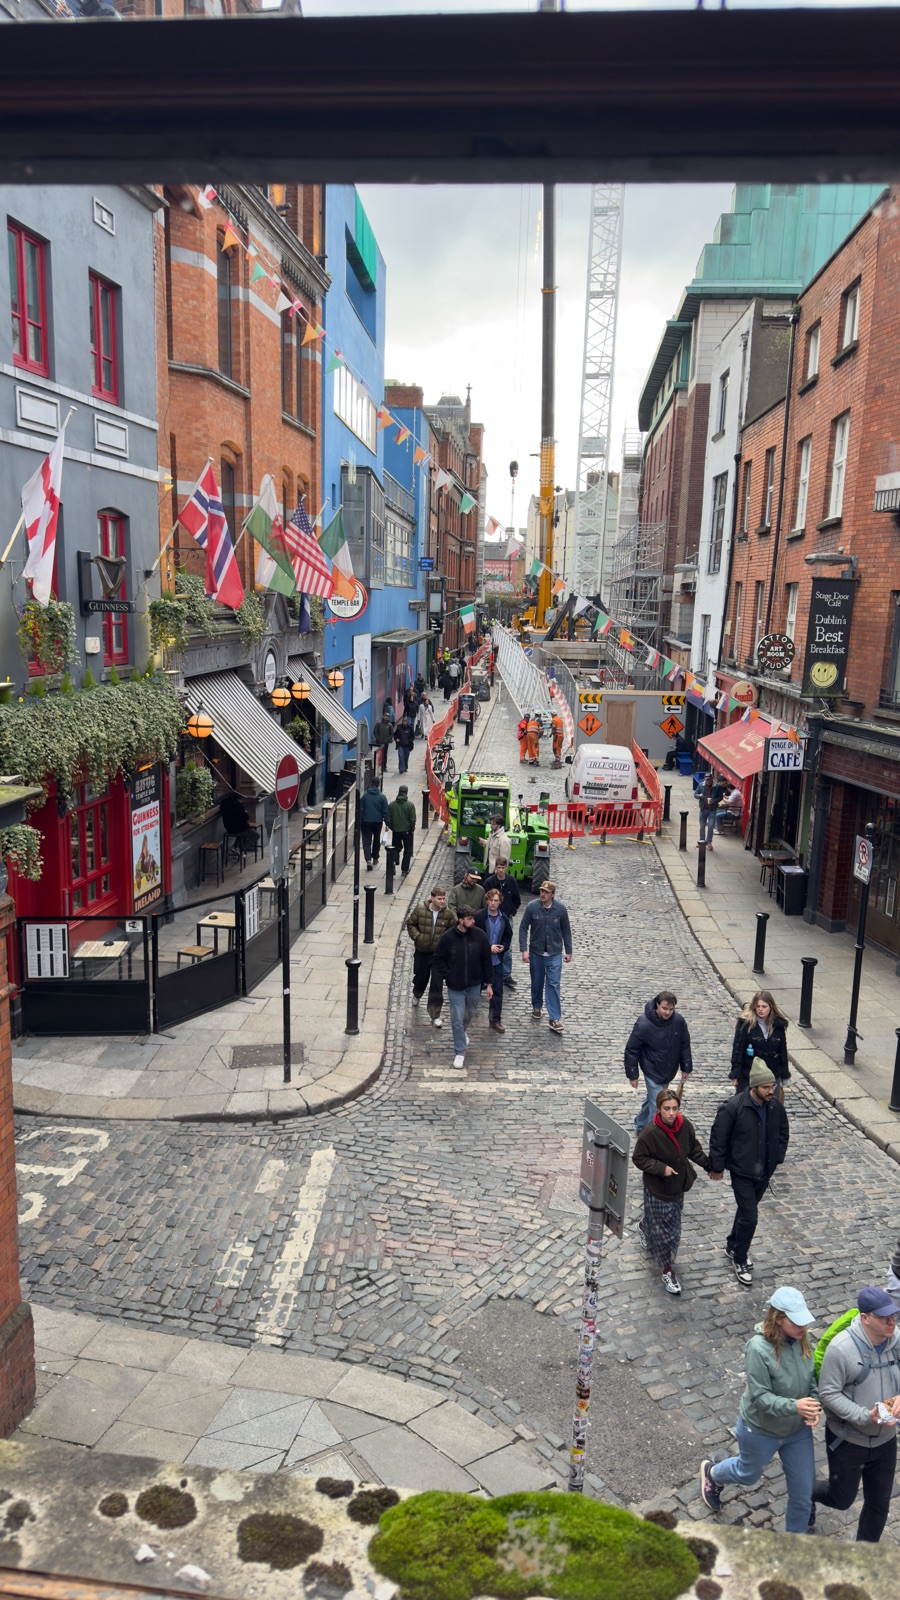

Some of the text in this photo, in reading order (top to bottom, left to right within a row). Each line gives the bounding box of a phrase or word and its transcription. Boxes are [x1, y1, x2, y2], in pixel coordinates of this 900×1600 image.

[815, 591, 849, 601] Stage Door
[89, 601, 129, 611] GUINNESS
[815, 614, 847, 625] Dublin's
[815, 626, 844, 643] Best
[760, 635, 793, 649] TATTOO
[810, 644, 845, 654] Breakfast
[761, 657, 790, 669] STUDIO
[132, 805, 159, 826] GUINNESS
[135, 887, 161, 912] IRELAND
